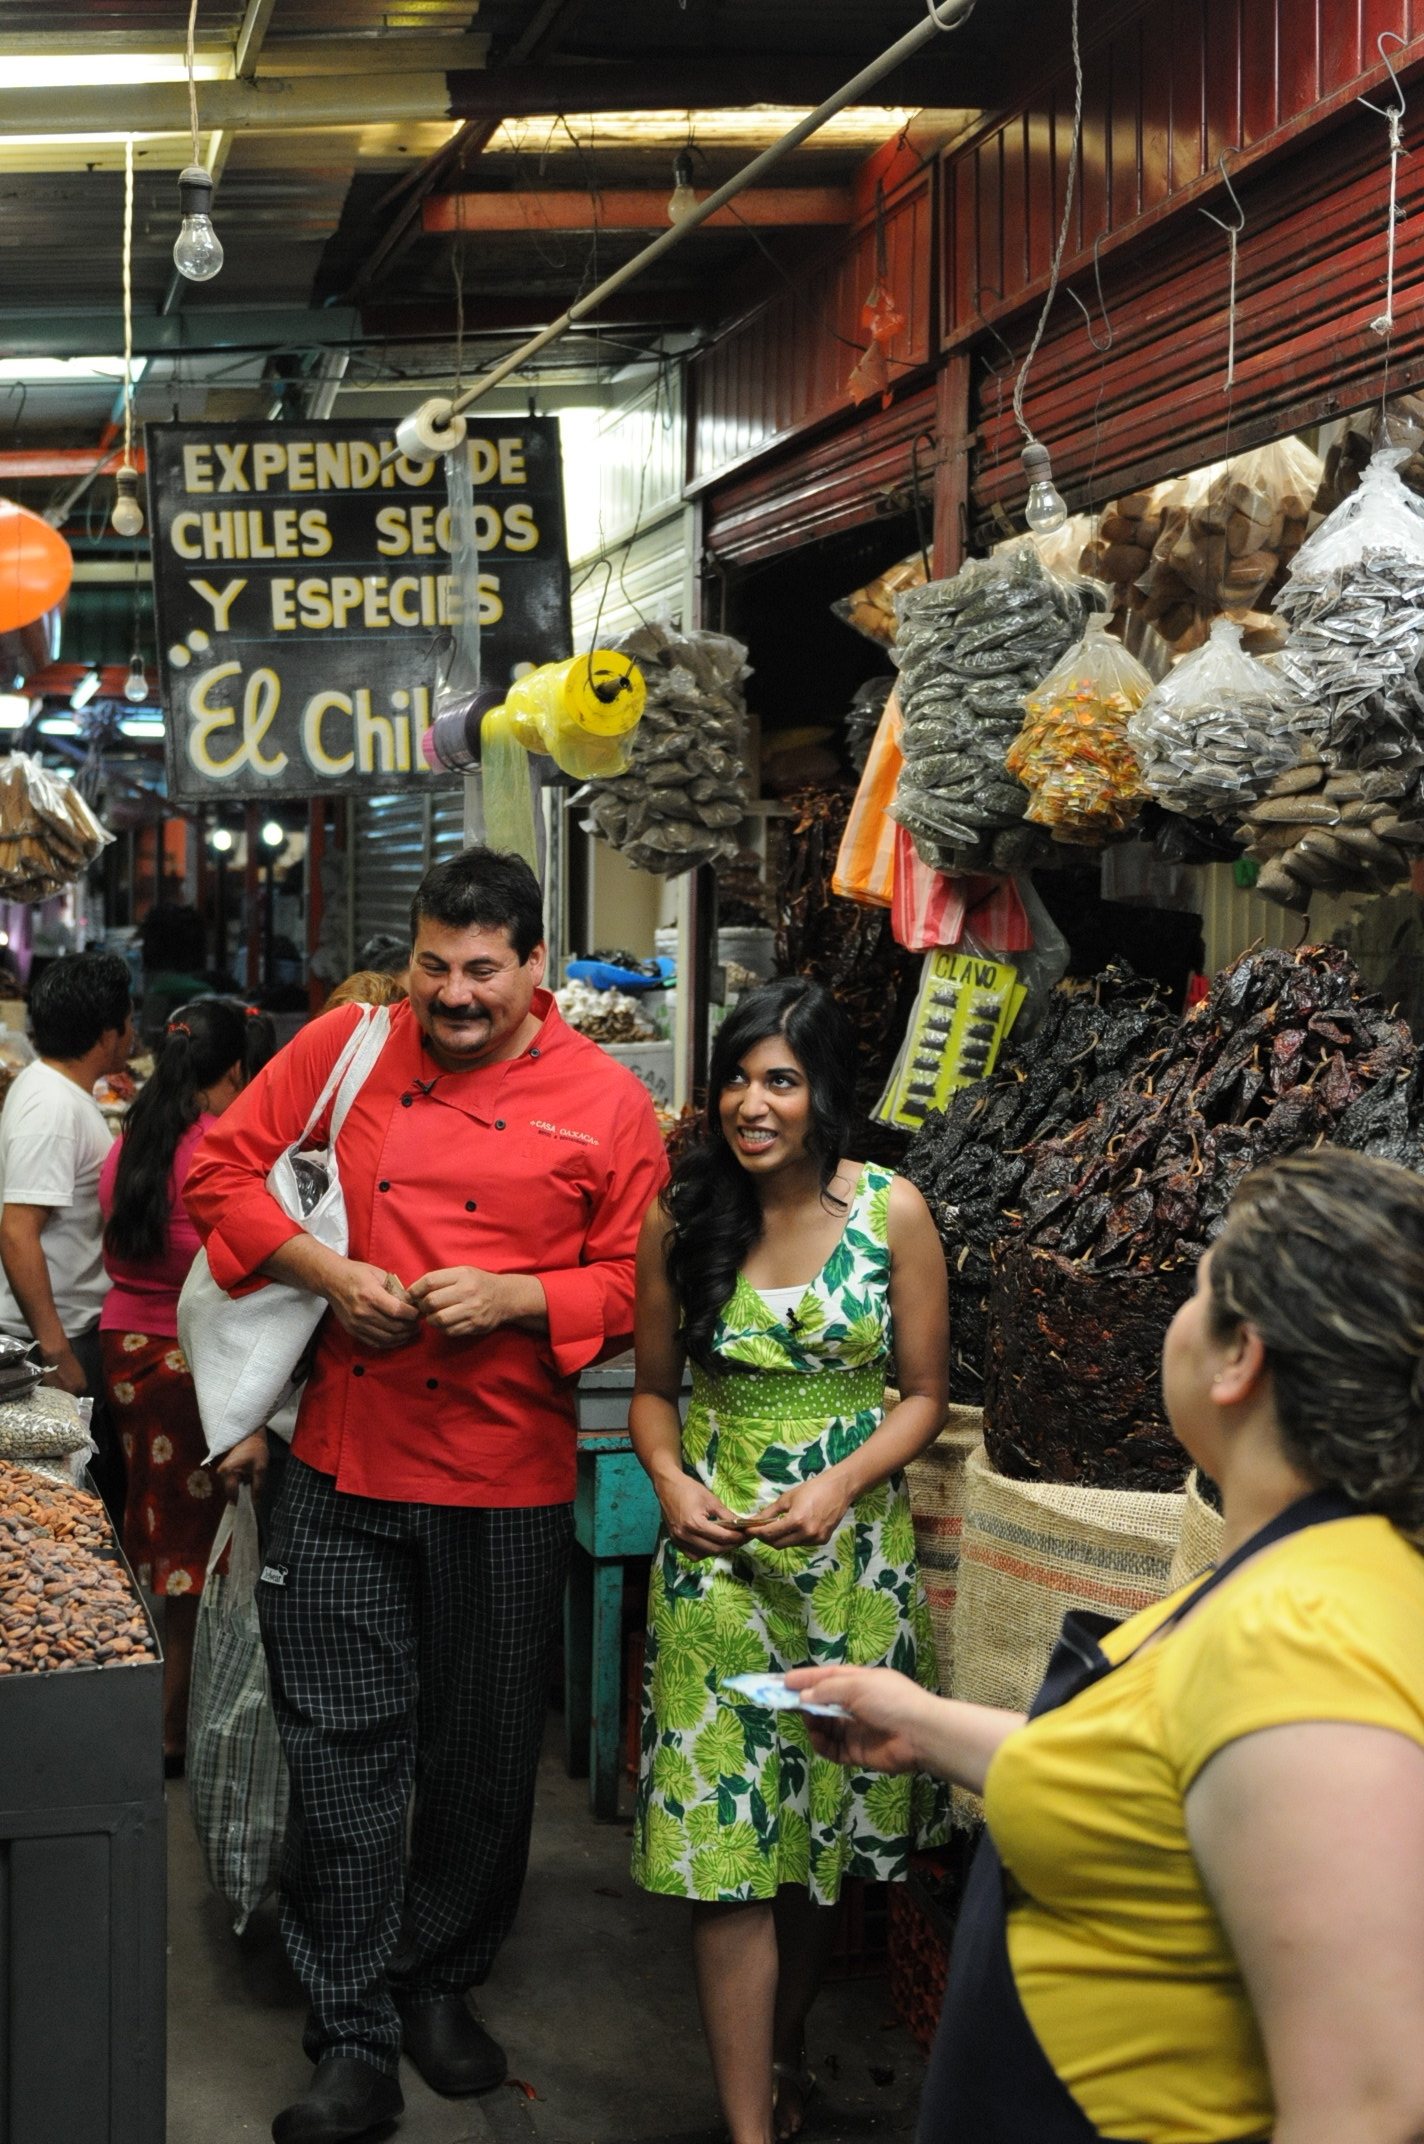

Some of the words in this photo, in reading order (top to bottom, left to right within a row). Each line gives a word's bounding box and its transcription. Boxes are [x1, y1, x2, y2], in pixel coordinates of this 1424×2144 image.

[183, 439, 436, 493] EXPENDIO
[466, 438, 527, 485] DE
[170, 509, 333, 560] CHILES
[375, 503, 540, 556] SECOS
[188, 578, 249, 632] Y
[270, 573, 504, 632] ESPECIES
[188, 660, 290, 779] El
[302, 686, 433, 776] Chil
[536, 1120, 556, 1133] CASA
